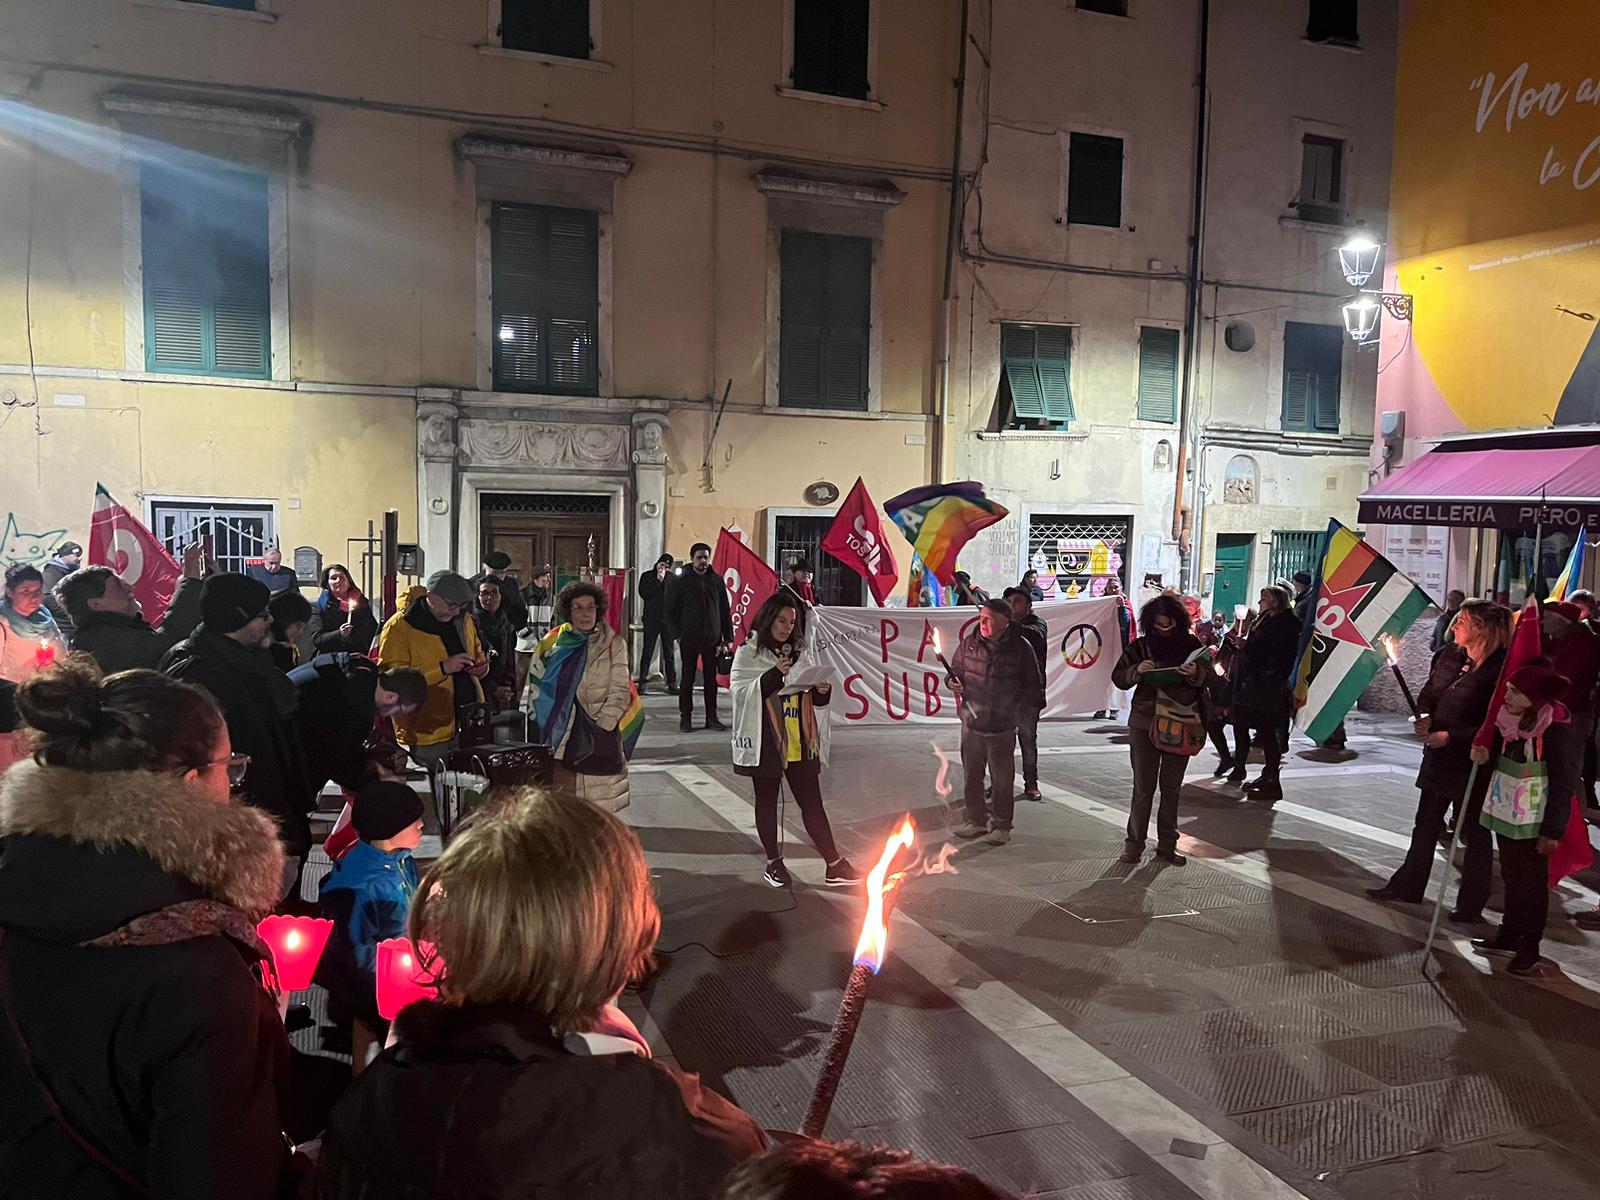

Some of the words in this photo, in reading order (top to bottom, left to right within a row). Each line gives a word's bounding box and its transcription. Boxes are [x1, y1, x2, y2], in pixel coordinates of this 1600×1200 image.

[1540, 146, 1565, 185] la
[1376, 504, 1496, 523] MACELLERIA
[1587, 514, 1599, 526] E
